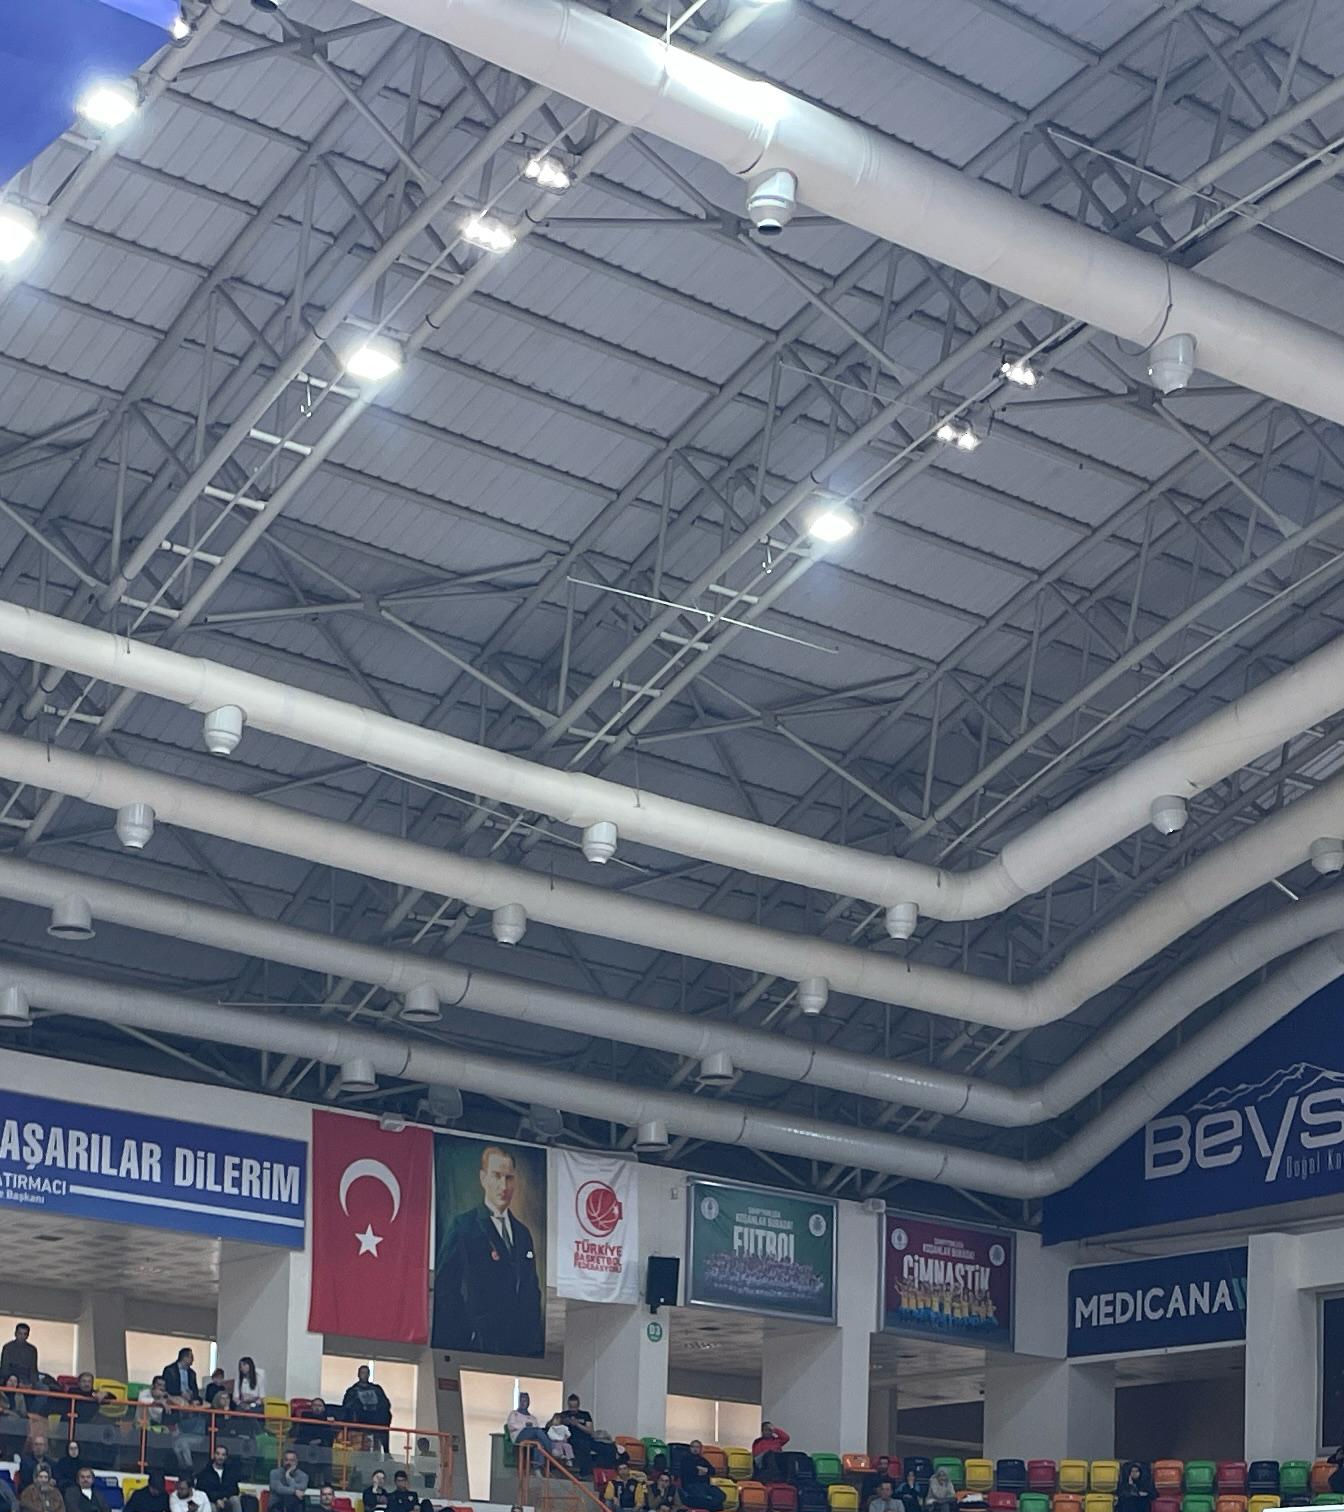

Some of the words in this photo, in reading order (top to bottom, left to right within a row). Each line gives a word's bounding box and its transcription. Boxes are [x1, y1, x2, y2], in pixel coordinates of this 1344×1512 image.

[6, 1189, 46, 1204] Başkanı
[573, 1238, 624, 1258] TÜRKİYE
[1074, 1279, 1234, 1329] MEDICANA
